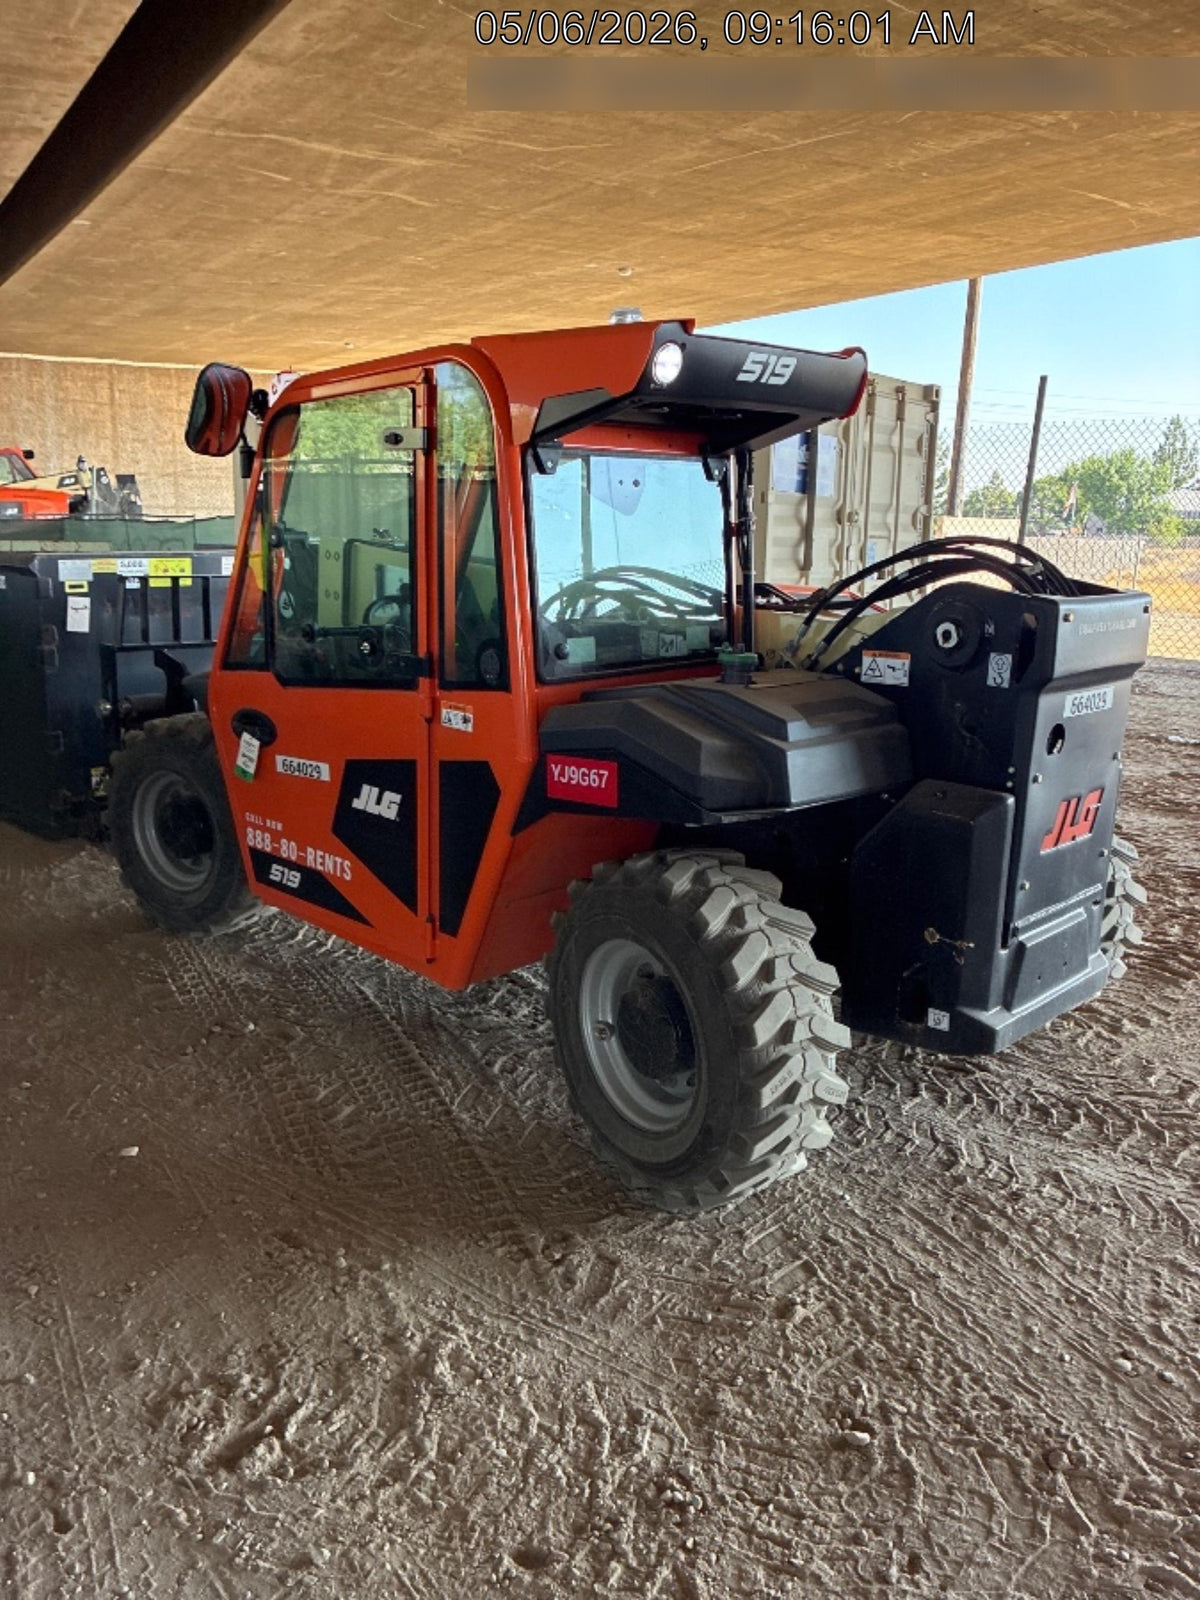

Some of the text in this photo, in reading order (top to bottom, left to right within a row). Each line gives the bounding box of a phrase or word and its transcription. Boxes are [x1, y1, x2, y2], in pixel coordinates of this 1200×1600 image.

[736, 351, 798, 386] 519
[1070, 690, 1108, 716] 664029
[281, 757, 322, 780] 664029
[550, 763, 609, 789] YJ9G67
[352, 783, 402, 821] JLG
[1039, 787, 1105, 855] JLG
[246, 827, 352, 881] 888-80-RENTS
[268, 863, 301, 888] 519
